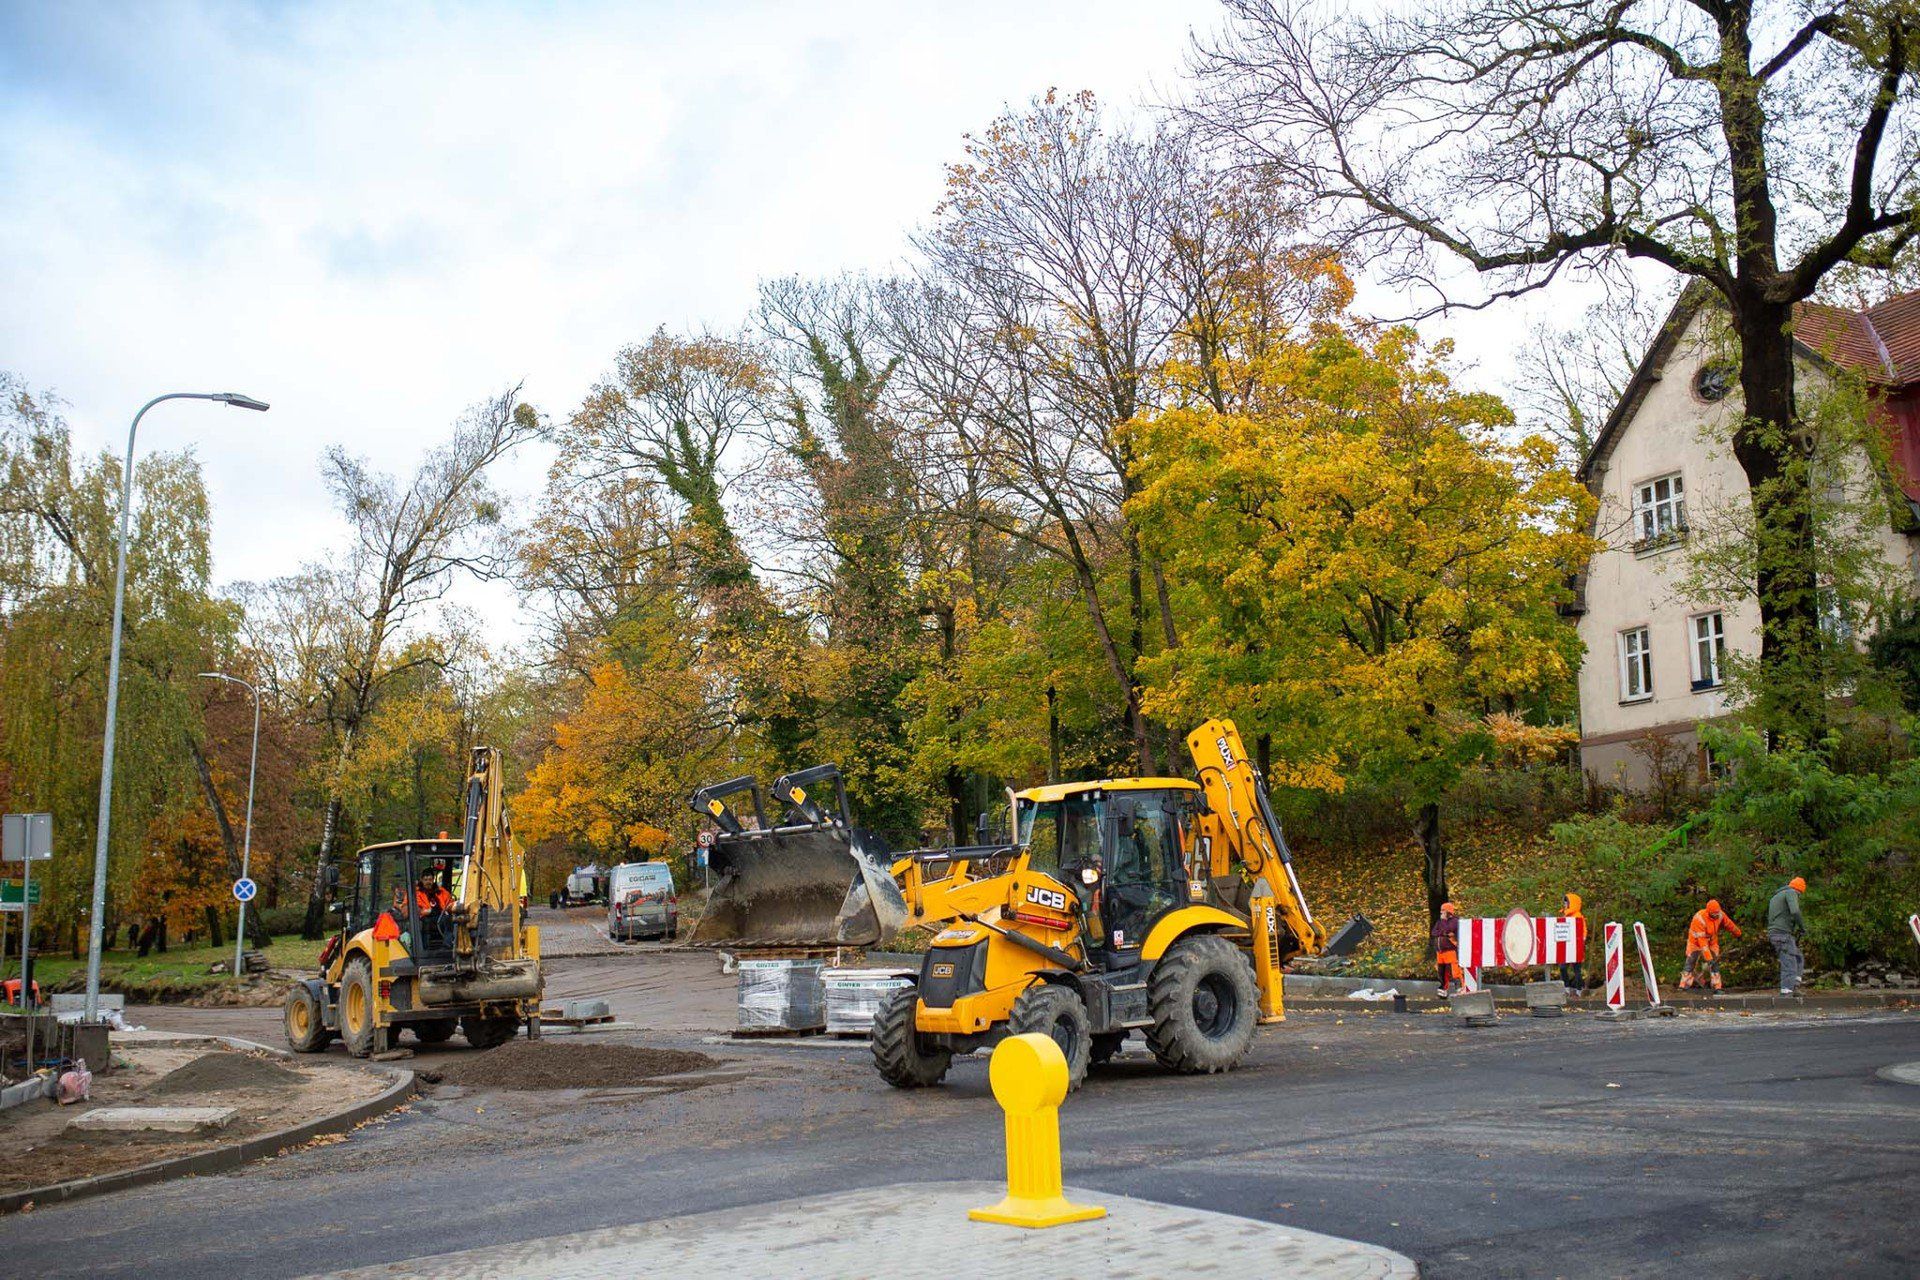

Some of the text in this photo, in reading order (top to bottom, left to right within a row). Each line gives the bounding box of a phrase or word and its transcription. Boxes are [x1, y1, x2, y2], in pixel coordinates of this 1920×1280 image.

[1216, 737, 1234, 766] 3CX
[701, 835, 712, 844] 30
[1027, 886, 1065, 910] JCB
[934, 966, 952, 975] JCB
